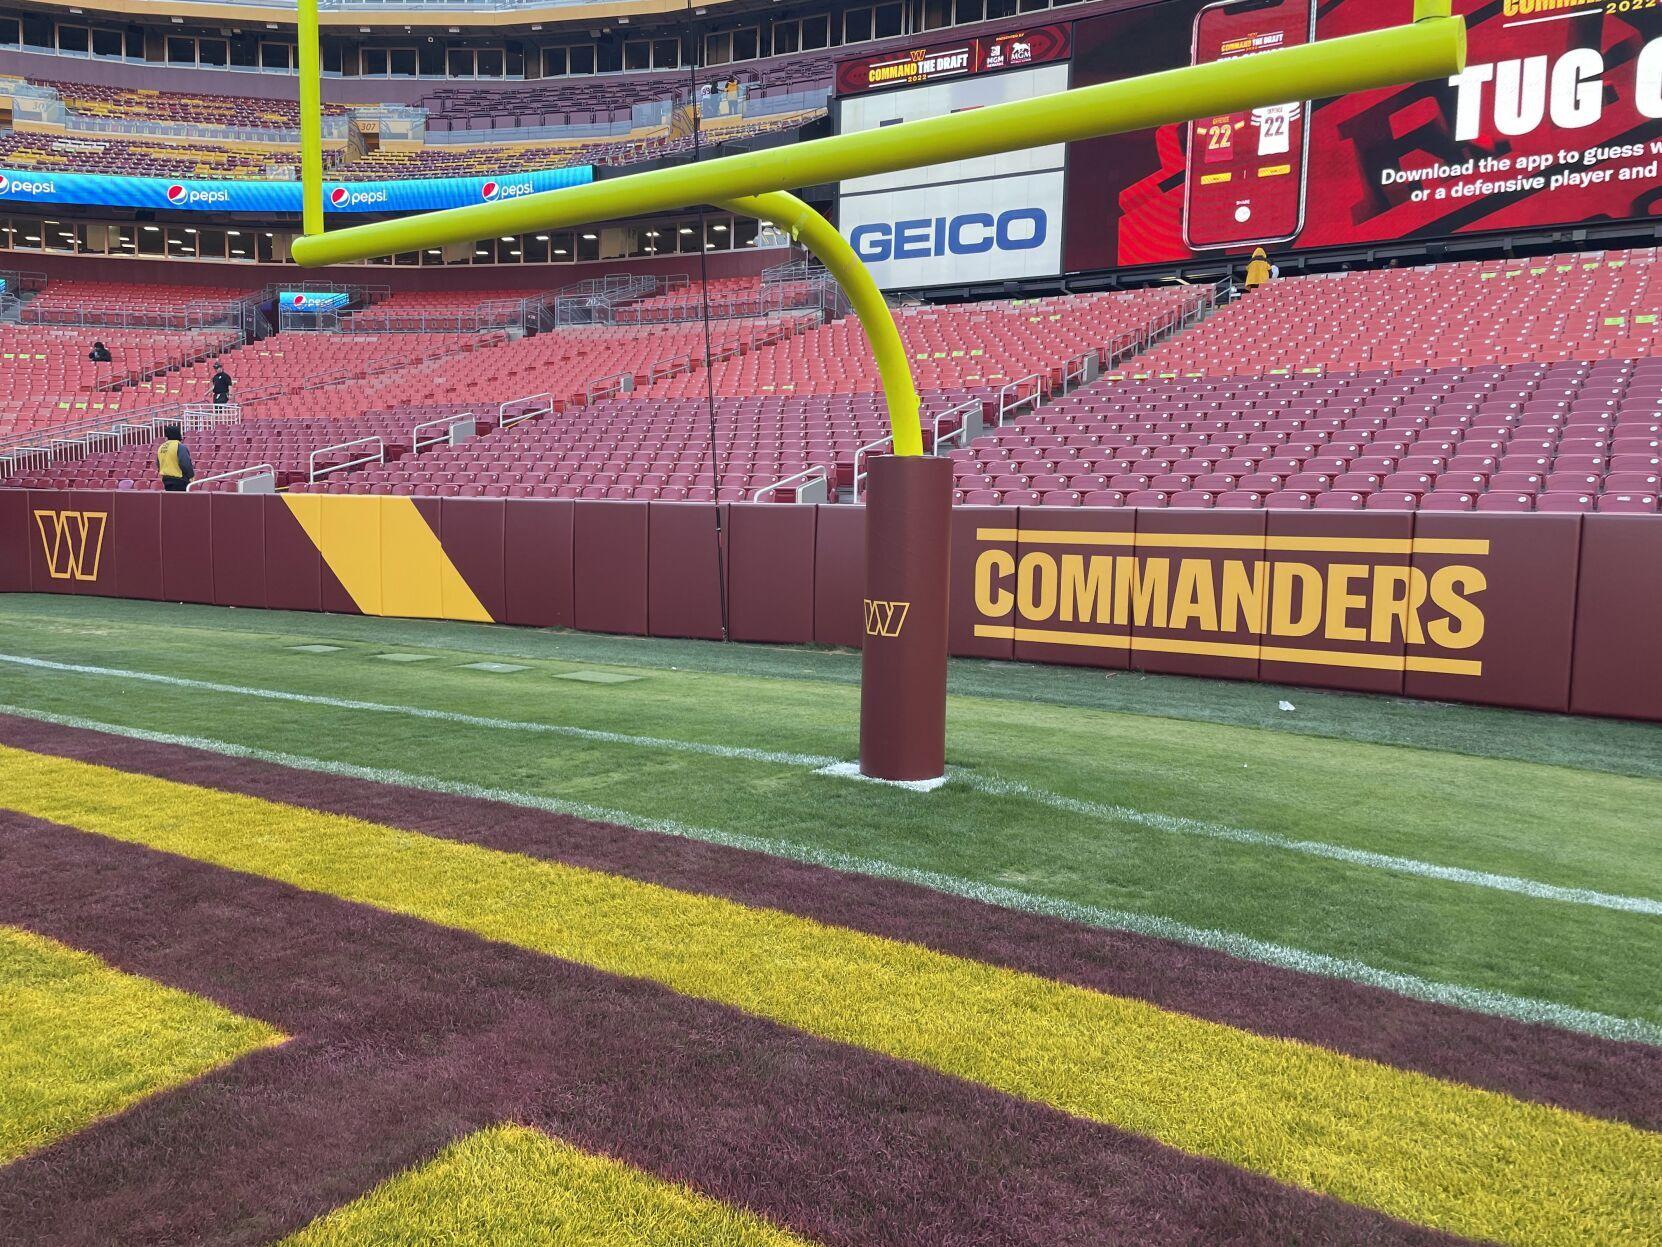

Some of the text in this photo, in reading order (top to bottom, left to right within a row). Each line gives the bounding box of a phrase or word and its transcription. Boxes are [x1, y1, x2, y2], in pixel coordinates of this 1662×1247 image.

[868, 62, 918, 82] COMMAND
[918, 59, 936, 74] THE
[936, 53, 969, 70] DRAFT
[1448, 47, 1604, 142] TUG
[361, 122, 376, 132] 307
[1208, 124, 1232, 150] 22
[1264, 115, 1285, 138] 22
[1381, 158, 1474, 185] Download
[1478, 156, 1511, 173] the
[1515, 152, 1553, 171] app
[1557, 149, 1579, 164] to
[1582, 143, 1645, 165] guess
[11, 179, 56, 195] pepsi
[501, 180, 534, 199] pepsi
[1411, 160, 1658, 202] or a defensive player and
[189, 188, 230, 203] pepsi
[351, 189, 387, 205] pepsi
[850, 207, 1047, 263] GEICO
[974, 549, 1487, 649] COMMANDERS
